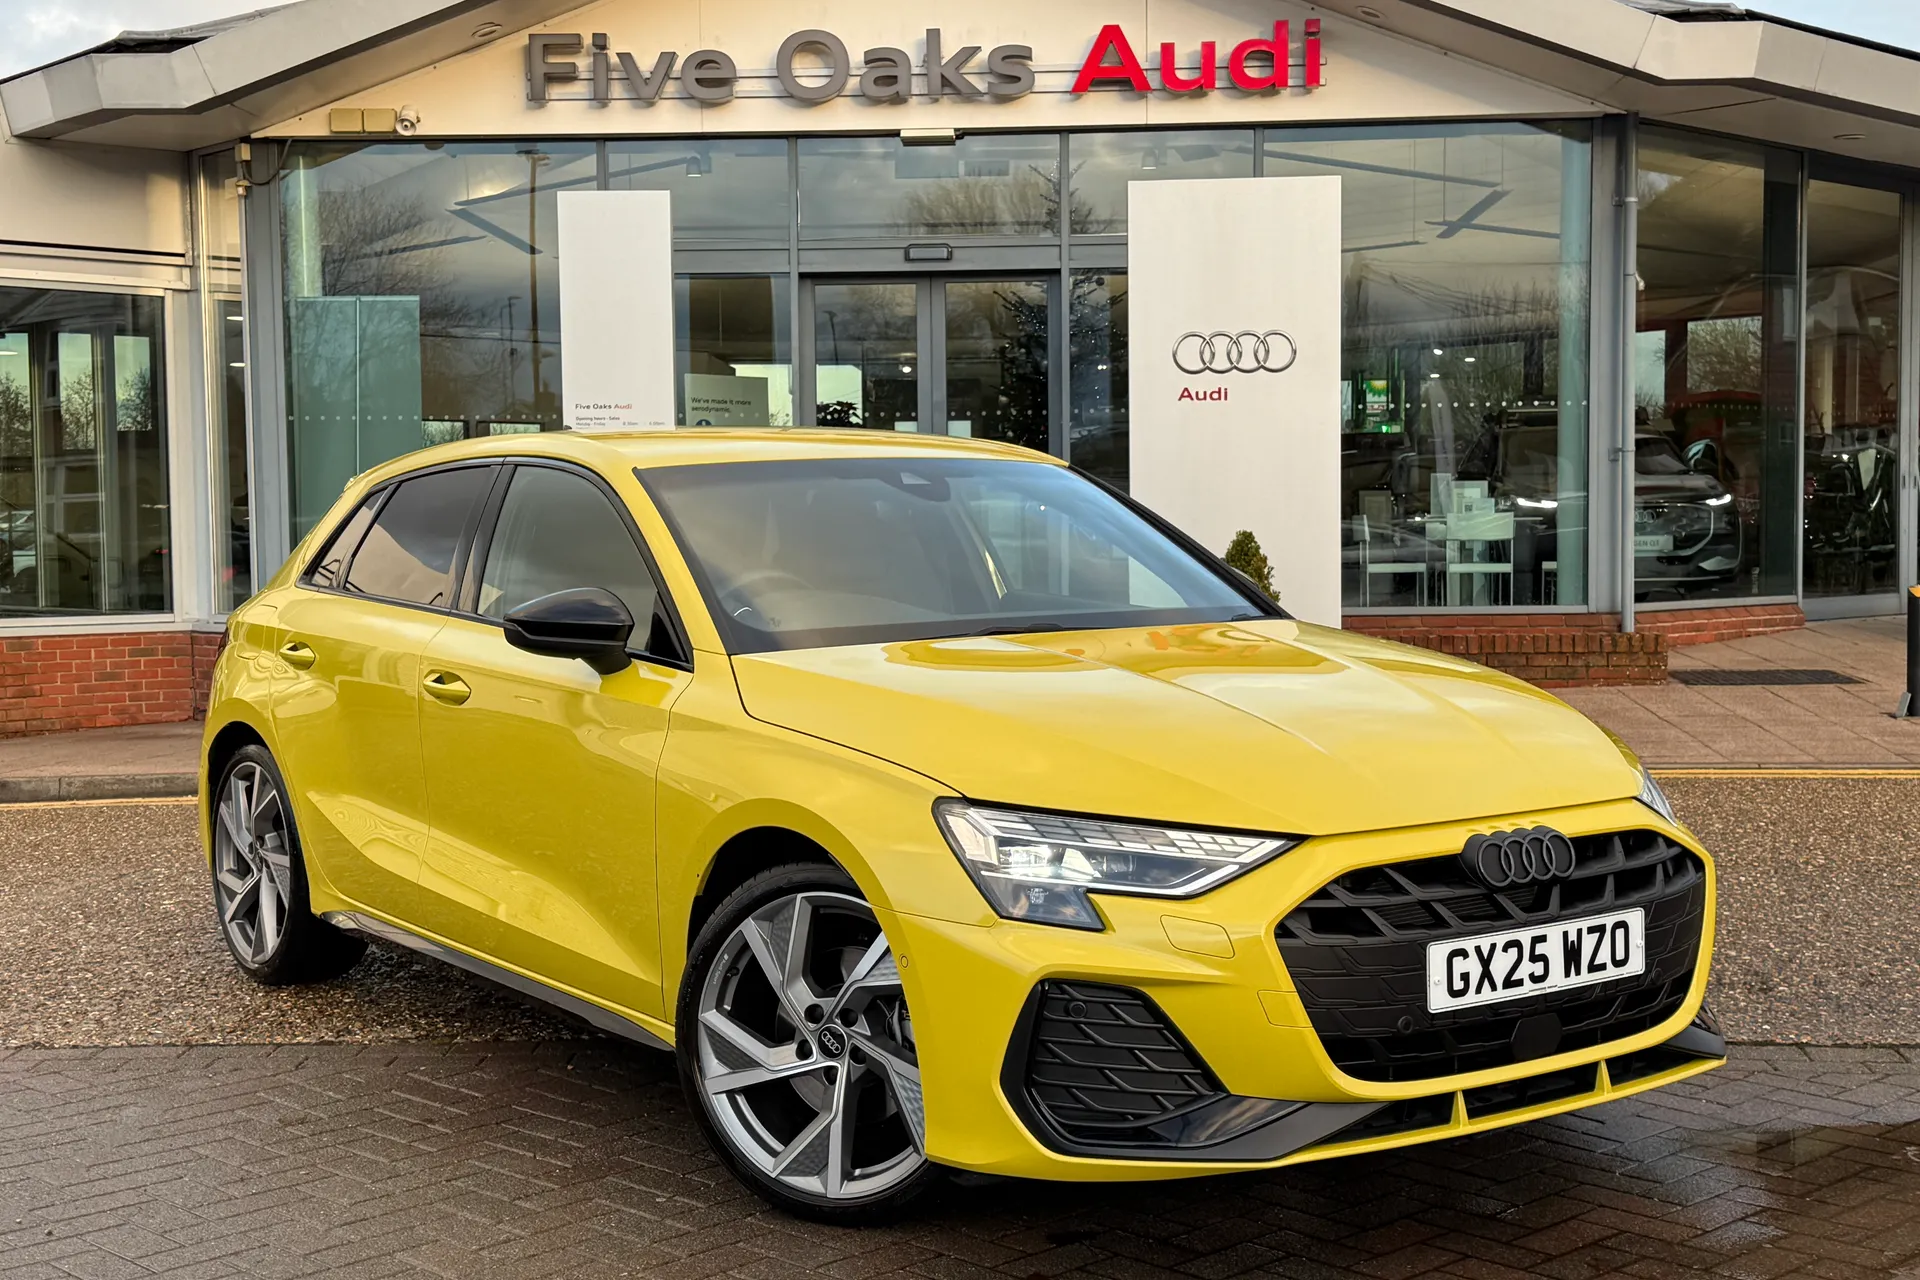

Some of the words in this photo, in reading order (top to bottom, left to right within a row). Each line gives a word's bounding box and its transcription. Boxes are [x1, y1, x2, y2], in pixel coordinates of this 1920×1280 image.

[526, 33, 737, 104] Five
[775, 28, 1036, 103] Oaks
[1069, 18, 1322, 94] Audi
[1178, 387, 1228, 401] Audi
[1446, 934, 1549, 999] GX25
[1562, 920, 1630, 978] WZO
